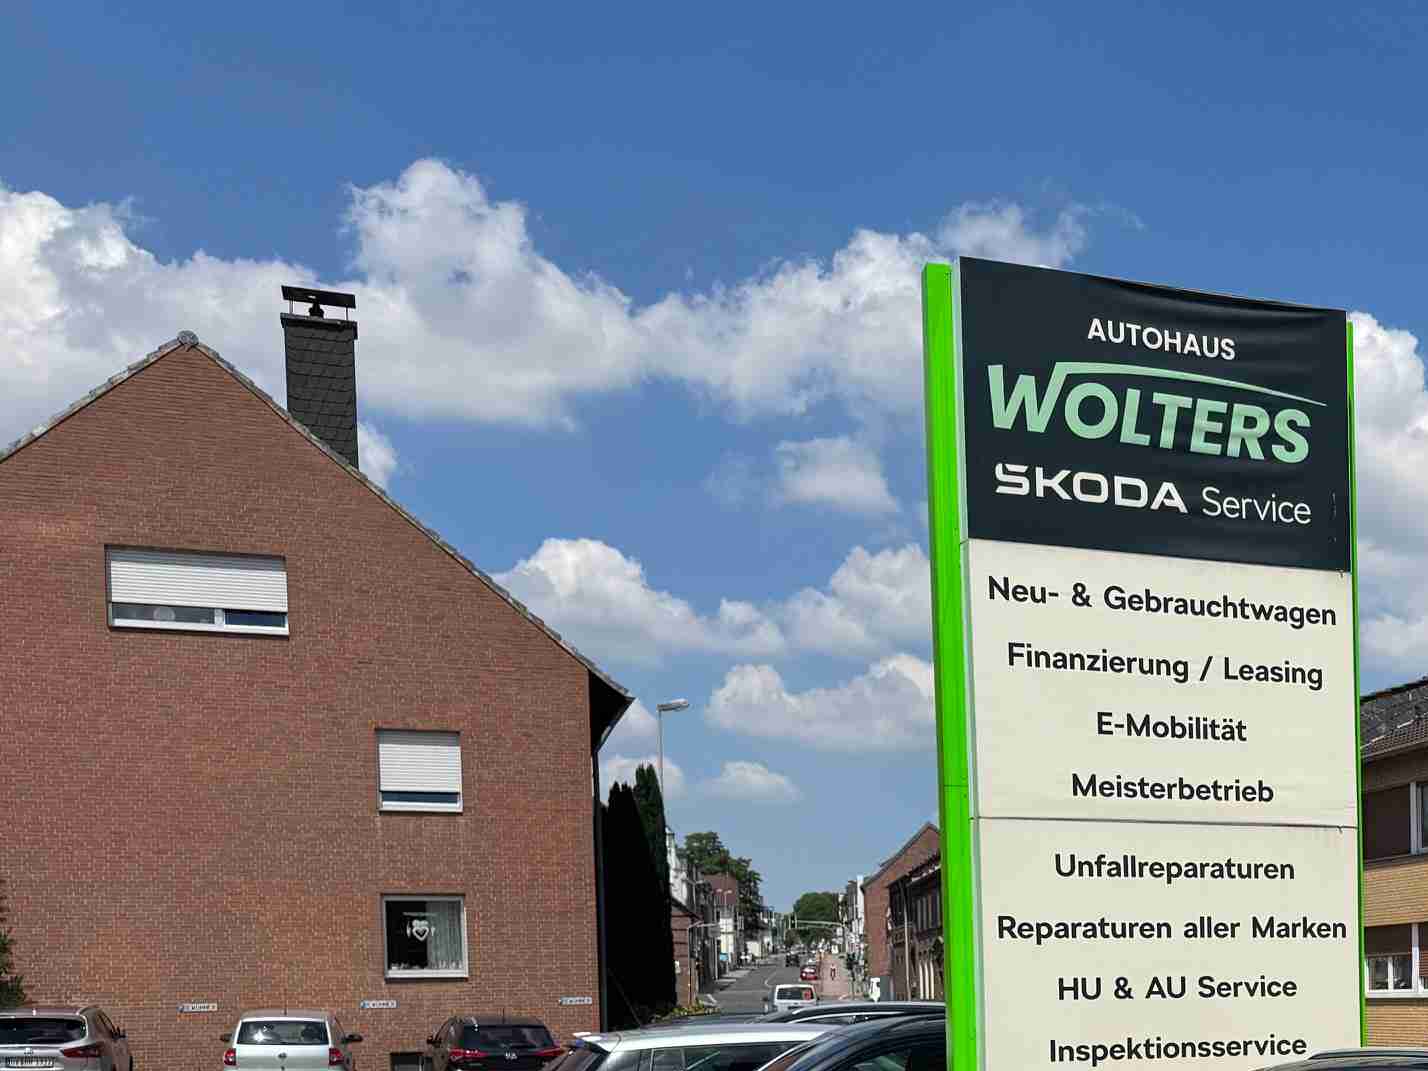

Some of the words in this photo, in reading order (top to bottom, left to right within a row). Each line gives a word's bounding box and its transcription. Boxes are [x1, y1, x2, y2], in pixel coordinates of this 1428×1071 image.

[1087, 318, 1236, 361] AUTOHAUS
[987, 361, 1312, 464] WOLTERS
[1202, 486, 1312, 524] Service
[988, 575, 1059, 604] Neu-
[1071, 582, 1093, 608] &
[1103, 585, 1337, 630] Gebrauchtwagen
[1007, 641, 1189, 684] Finanzierung
[1199, 655, 1214, 682] /
[1224, 656, 1323, 691] Leasing
[1096, 711, 1248, 743] E-Mobilität
[1071, 773, 1275, 803] Meisterbetrieb
[1054, 853, 1296, 885] Unfallreparaturen
[997, 915, 1172, 946] Reparaturen
[1183, 915, 1241, 939] aller
[1251, 916, 1347, 939] Marken
[1057, 976, 1102, 1001] HU
[1113, 976, 1134, 1000] &
[1145, 975, 1186, 999] AU
[1198, 974, 1298, 999] Service
[1049, 1033, 1308, 1067] Inspektionsservice
